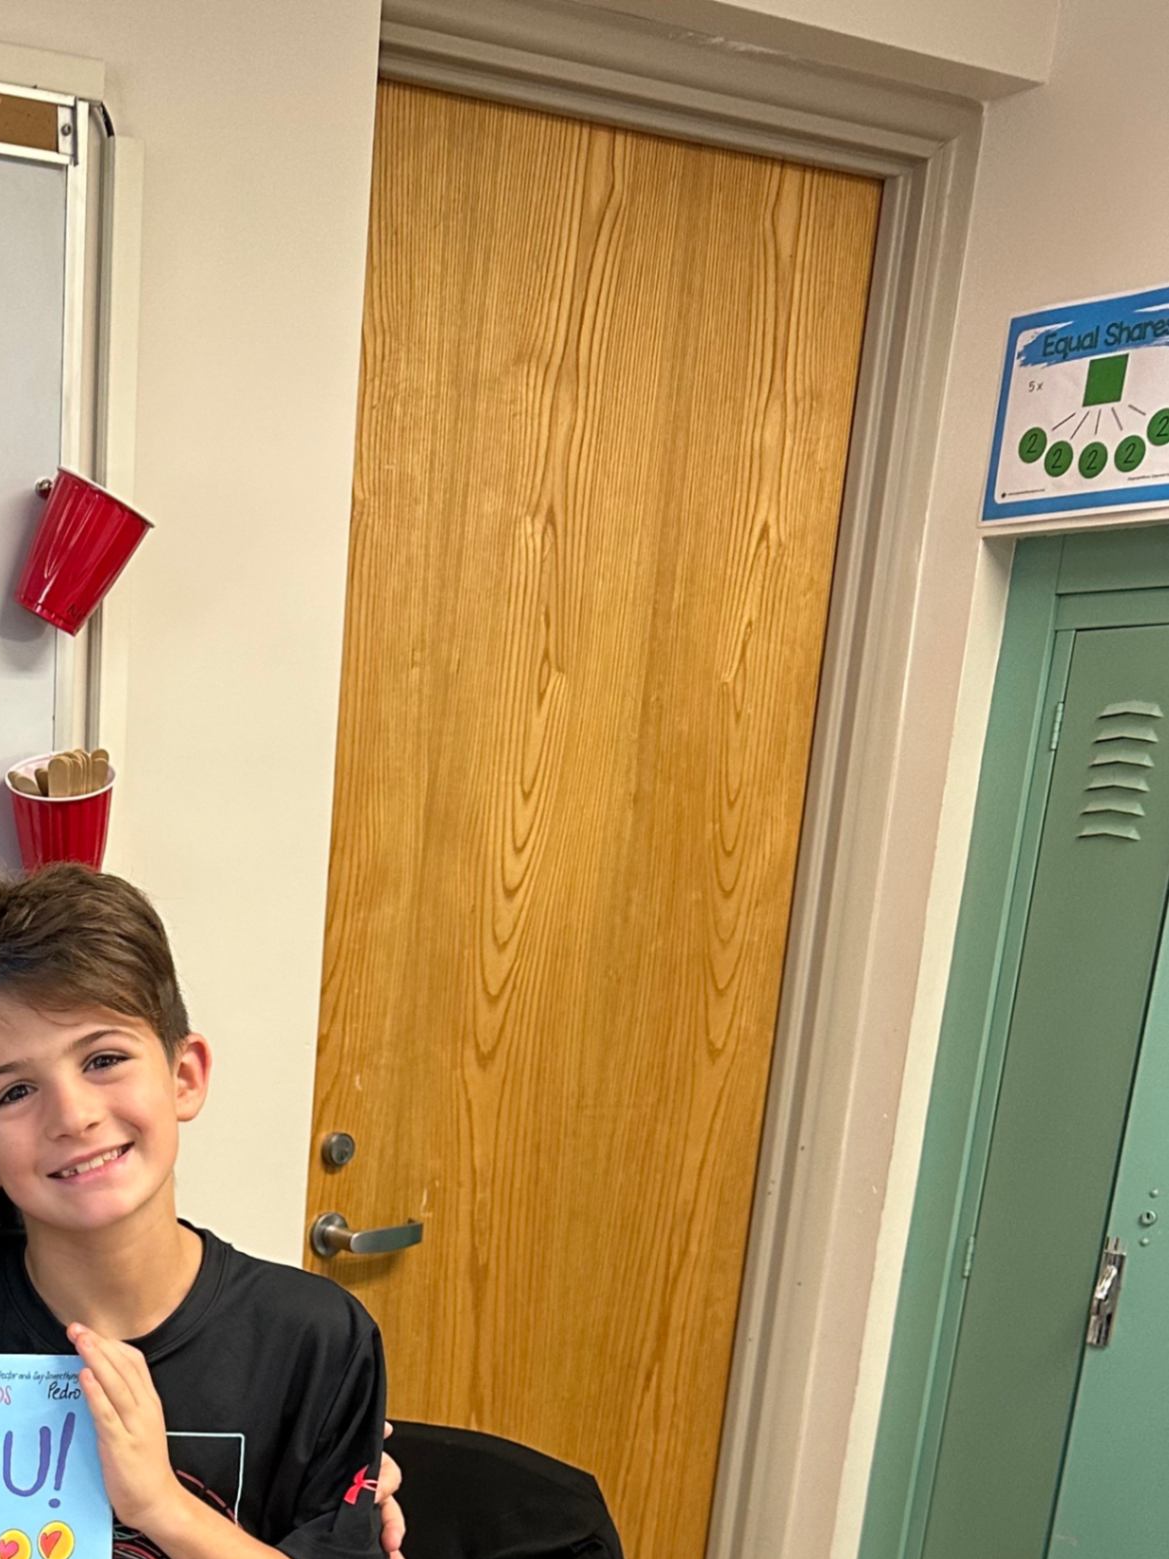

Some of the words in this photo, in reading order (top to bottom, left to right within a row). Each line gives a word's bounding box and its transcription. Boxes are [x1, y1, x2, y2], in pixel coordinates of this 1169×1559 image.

[1042, 325, 1099, 359] Equal
[1104, 318, 1169, 346] Shares
[1157, 415, 1169, 437] 2
[1027, 433, 1039, 454] 2
[1124, 442, 1137, 465] 2
[1053, 448, 1064, 470] 2
[1086, 449, 1098, 471] 2
